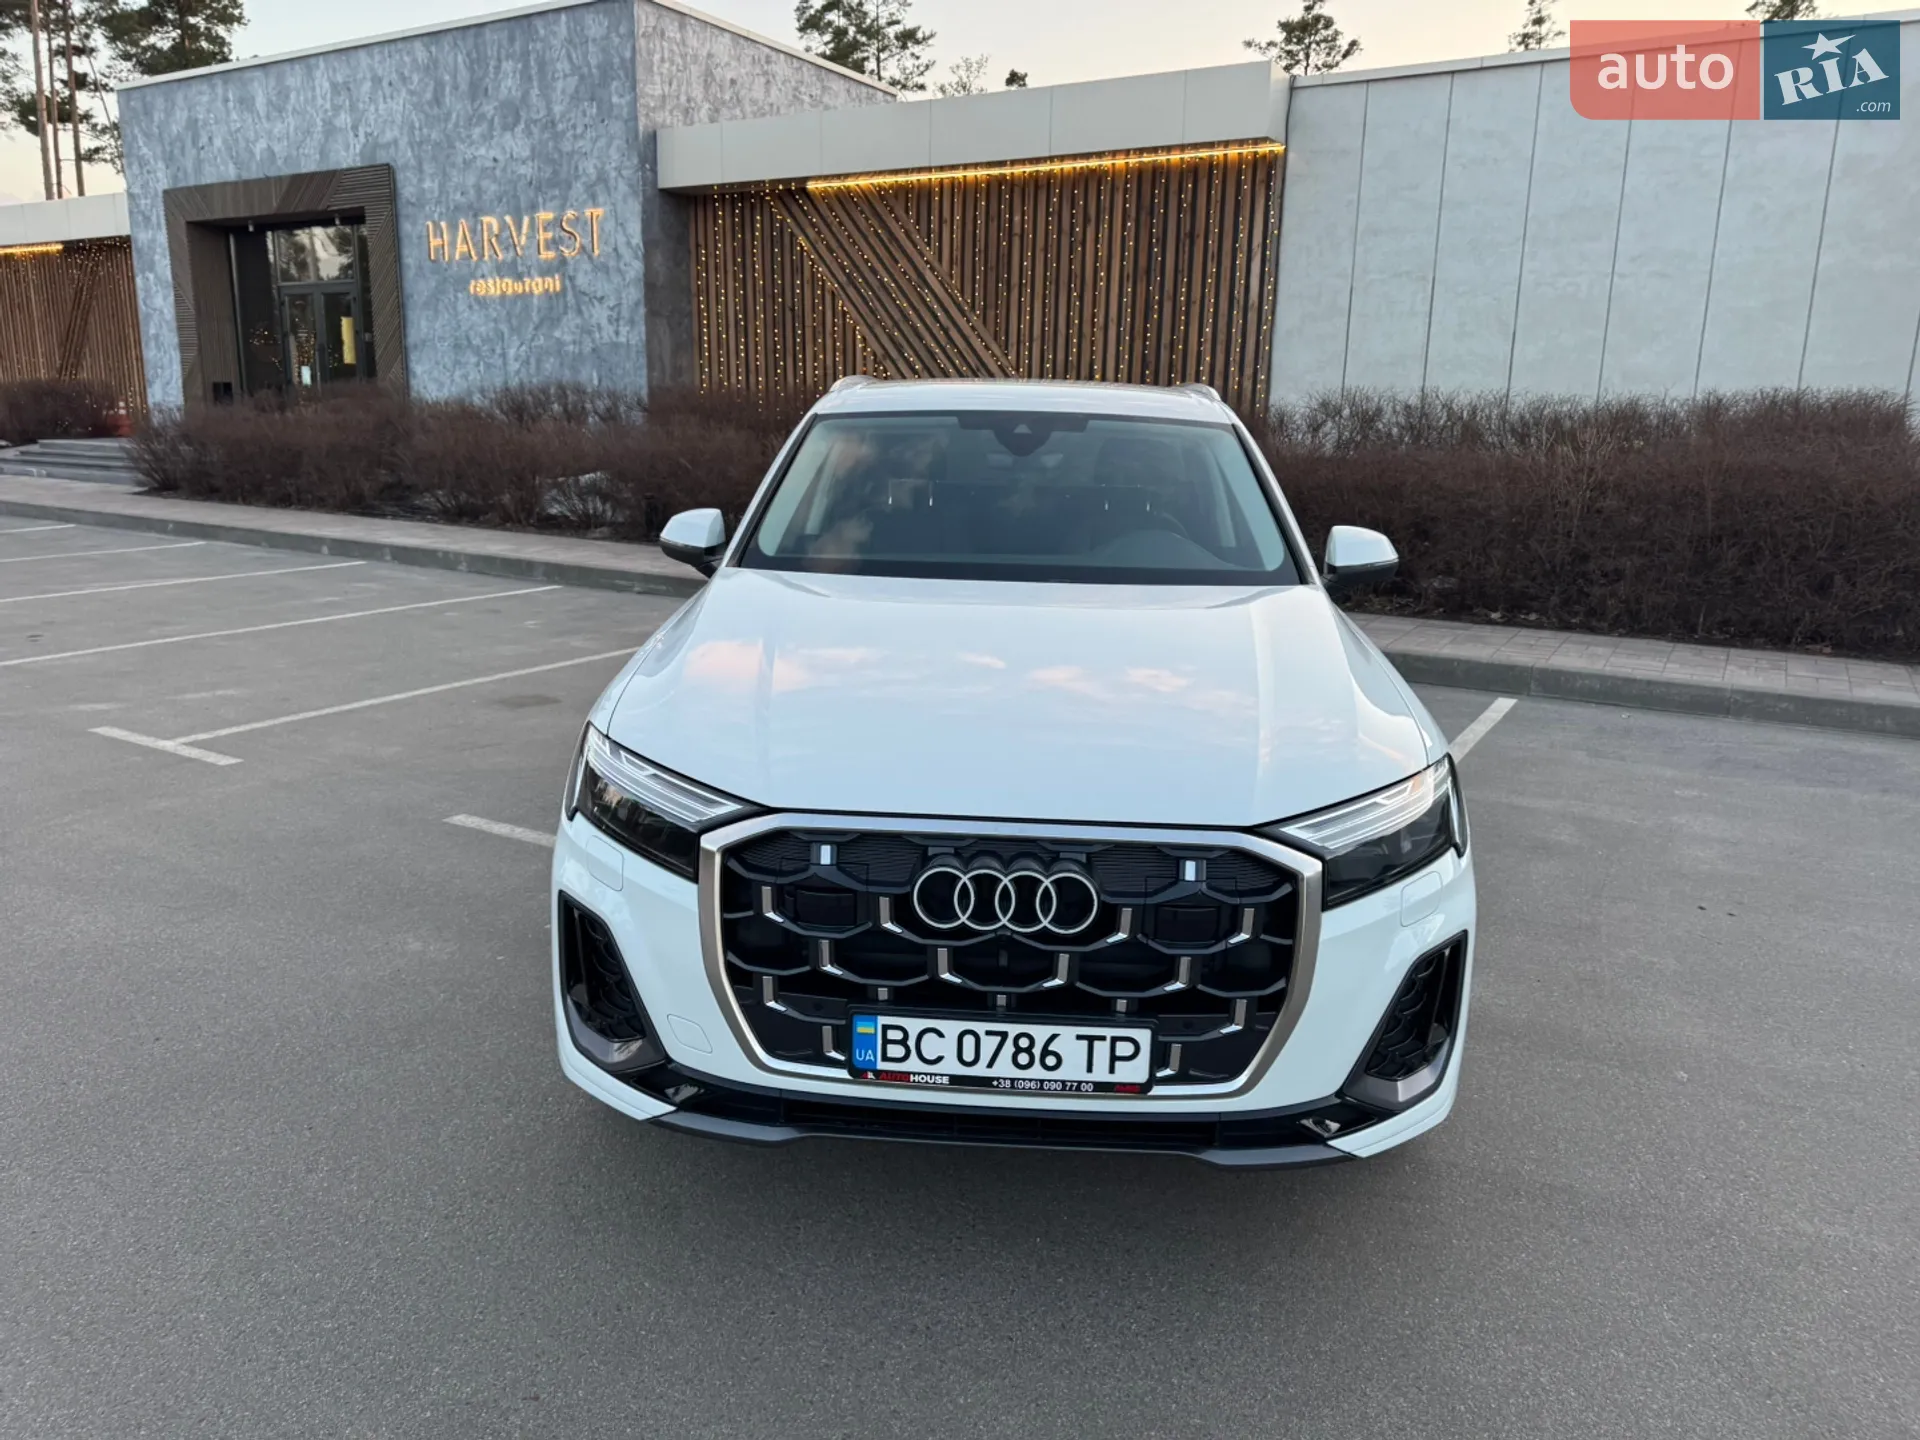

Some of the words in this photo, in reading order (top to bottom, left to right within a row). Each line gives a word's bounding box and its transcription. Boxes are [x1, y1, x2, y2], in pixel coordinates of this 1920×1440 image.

[426, 208, 604, 262] HARVEST
[469, 274, 562, 296] restaurant
[855, 1049, 875, 1062] UA
[880, 1023, 945, 1066] BC
[956, 1028, 1063, 1072] 0786
[1075, 1033, 1141, 1074] TP
[991, 1079, 1011, 1088] +38
[1014, 1079, 1041, 1090] (096)
[1043, 1081, 1063, 1091] 090
[1065, 1082, 1078, 1091] 77
[1080, 1082, 1094, 1092] 00
